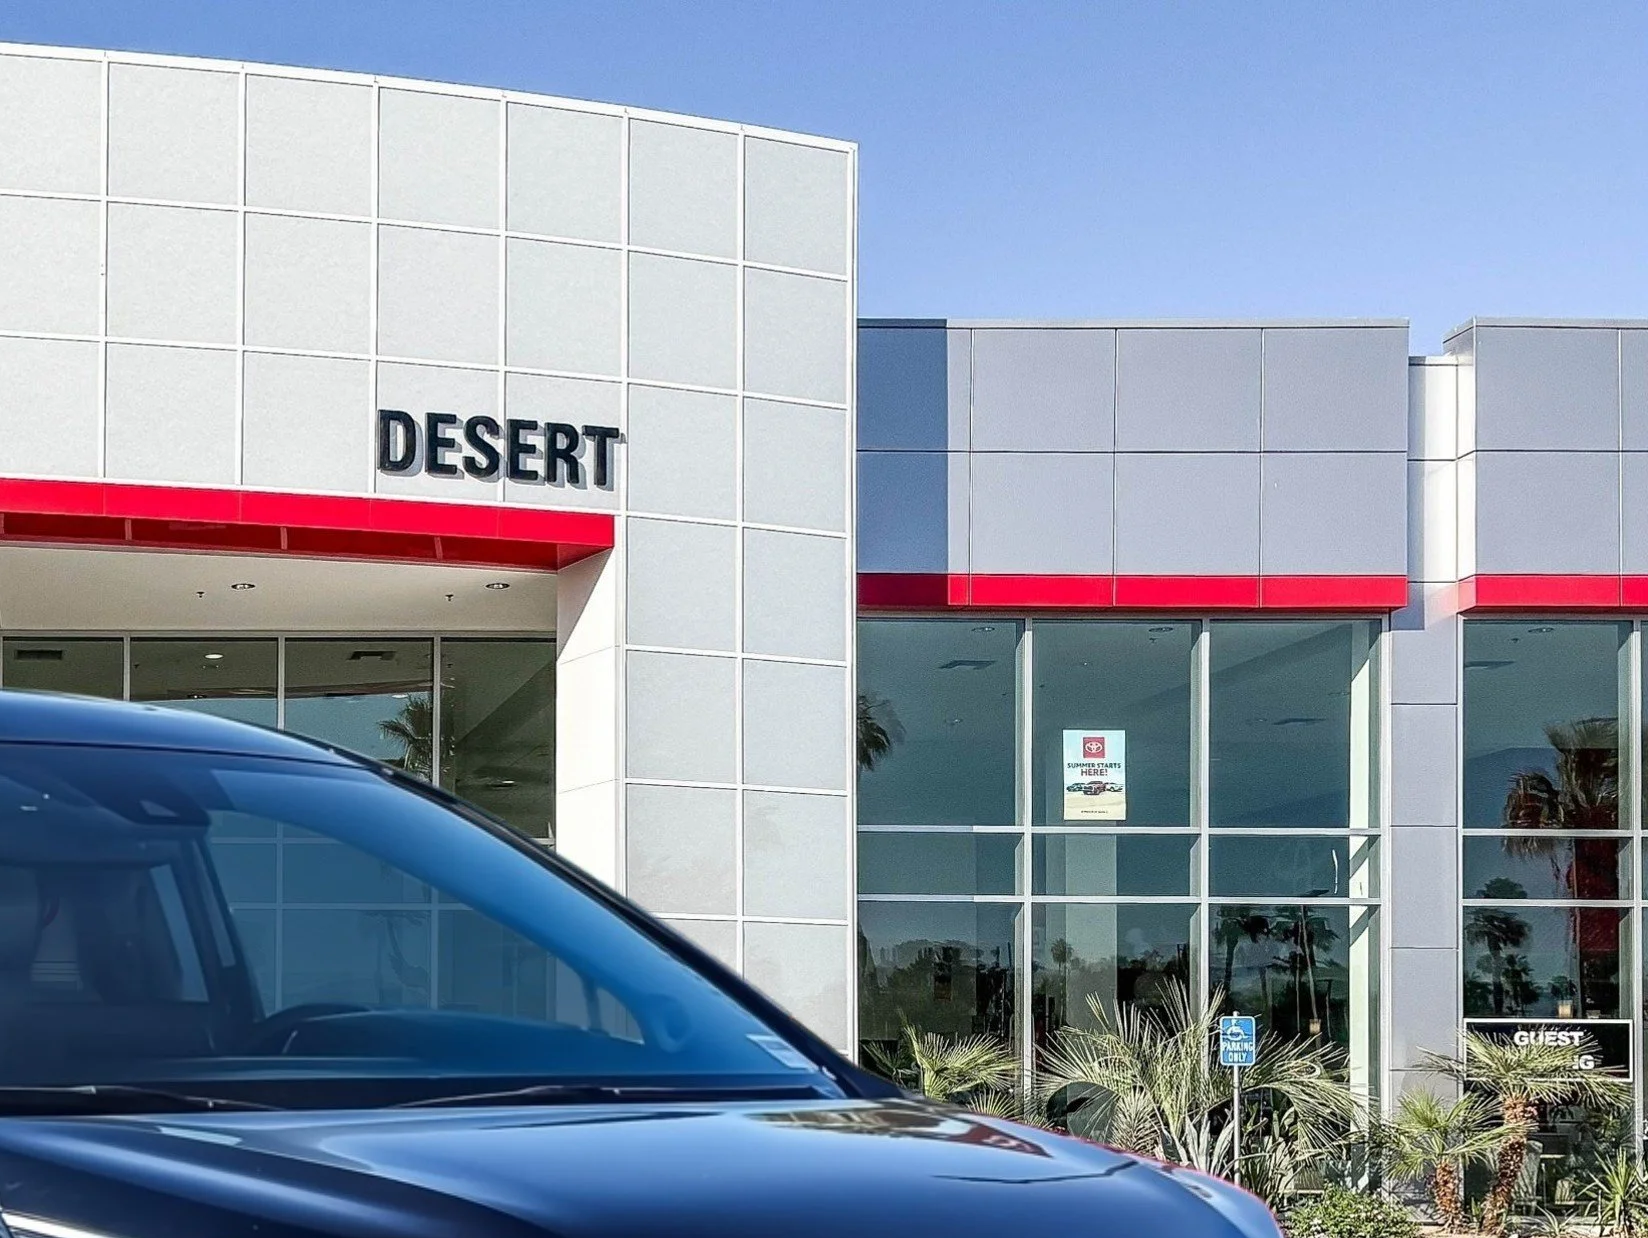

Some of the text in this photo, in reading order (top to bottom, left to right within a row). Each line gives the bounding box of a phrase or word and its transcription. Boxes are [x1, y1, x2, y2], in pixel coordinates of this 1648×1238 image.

[377, 409, 620, 486] DESERT
[1080, 768, 1108, 777] HERE!
[1513, 1031, 1584, 1046] GUEST
[1222, 1041, 1254, 1051] PARKING
[1228, 1052, 1247, 1062] ONLY
